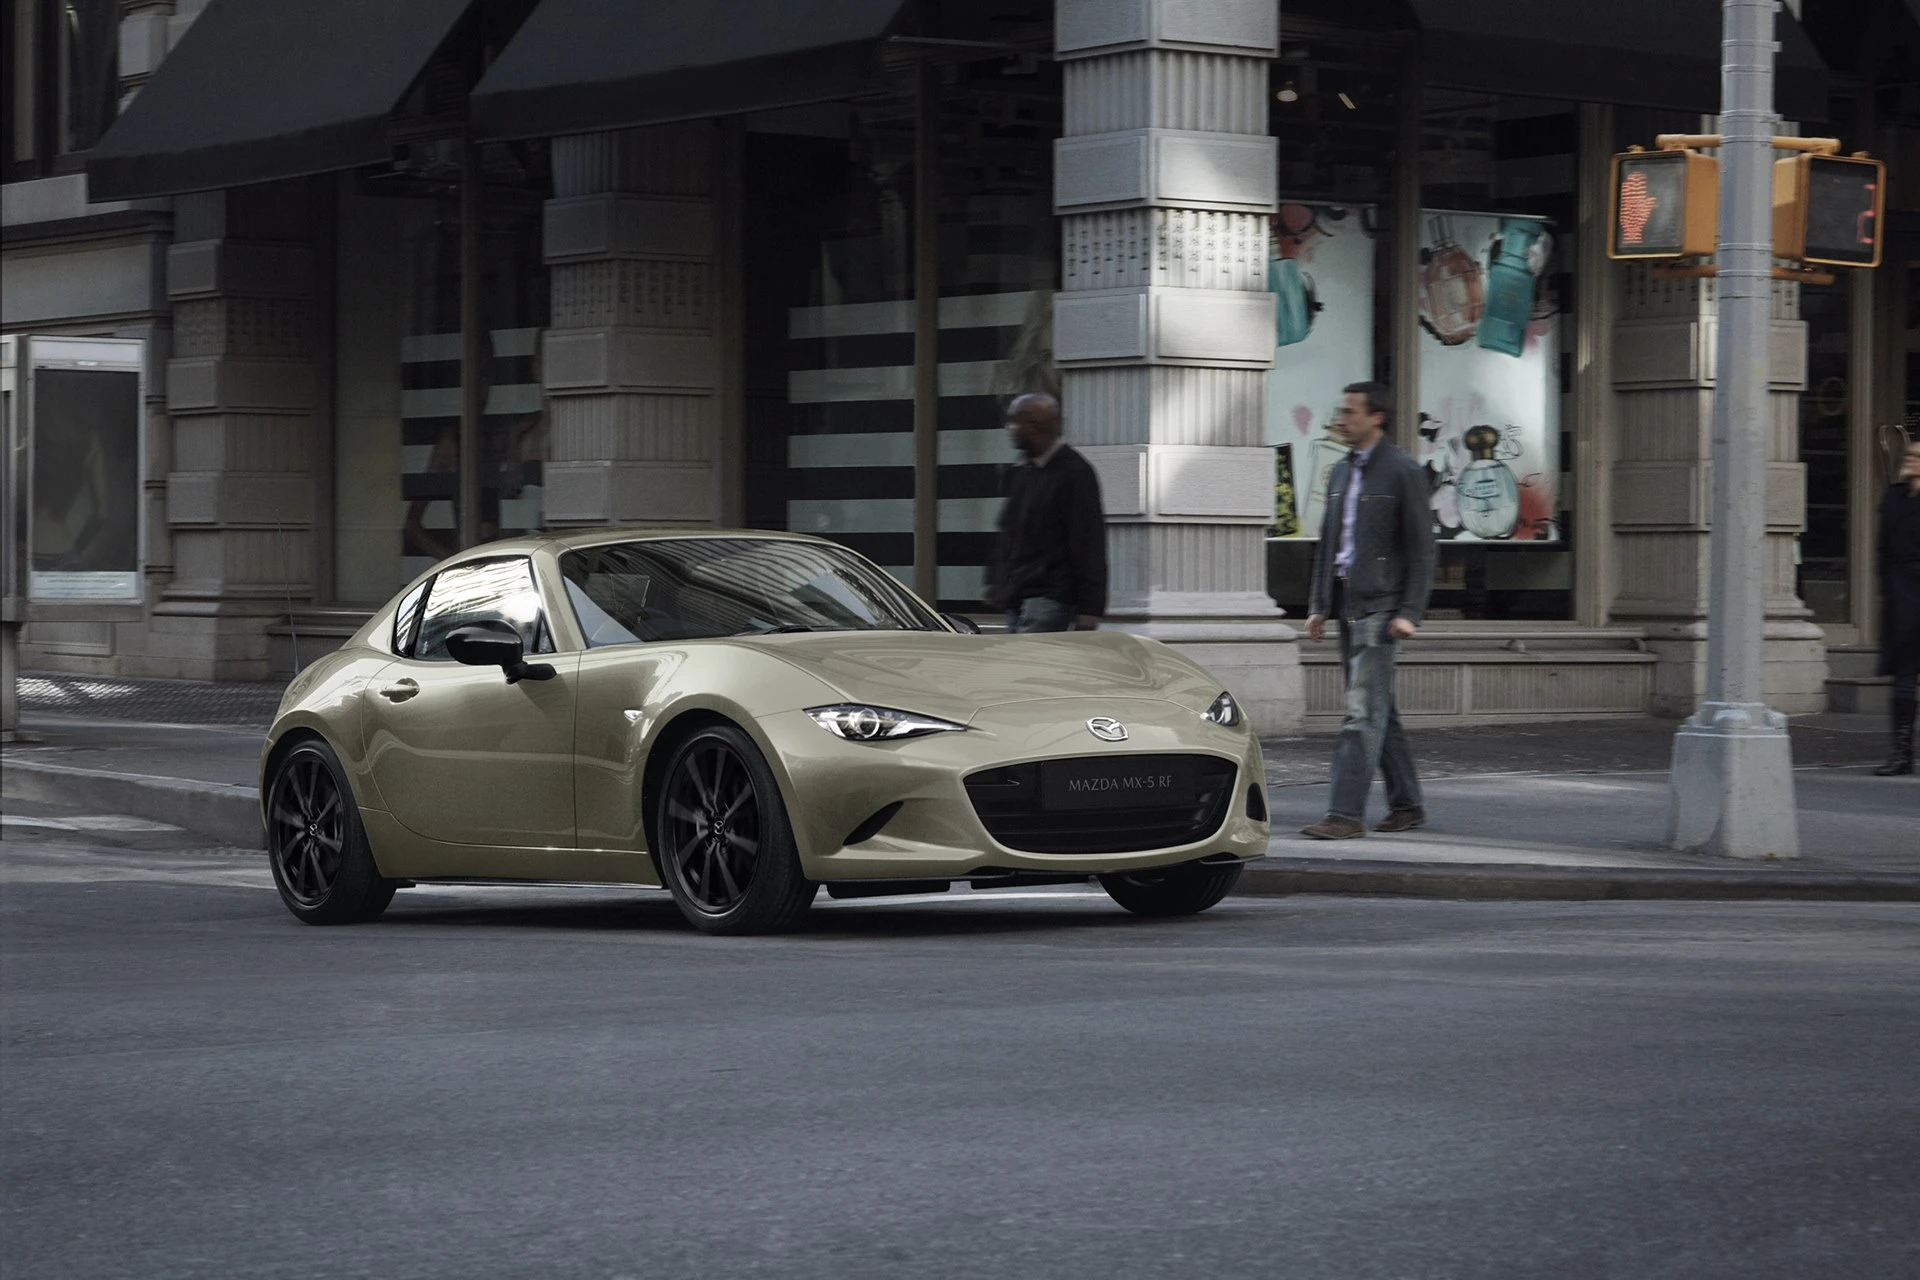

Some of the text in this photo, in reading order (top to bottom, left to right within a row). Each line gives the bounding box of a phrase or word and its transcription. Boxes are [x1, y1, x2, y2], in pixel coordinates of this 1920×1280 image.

[1069, 775, 1172, 791] MAZDA MX-5 RF
